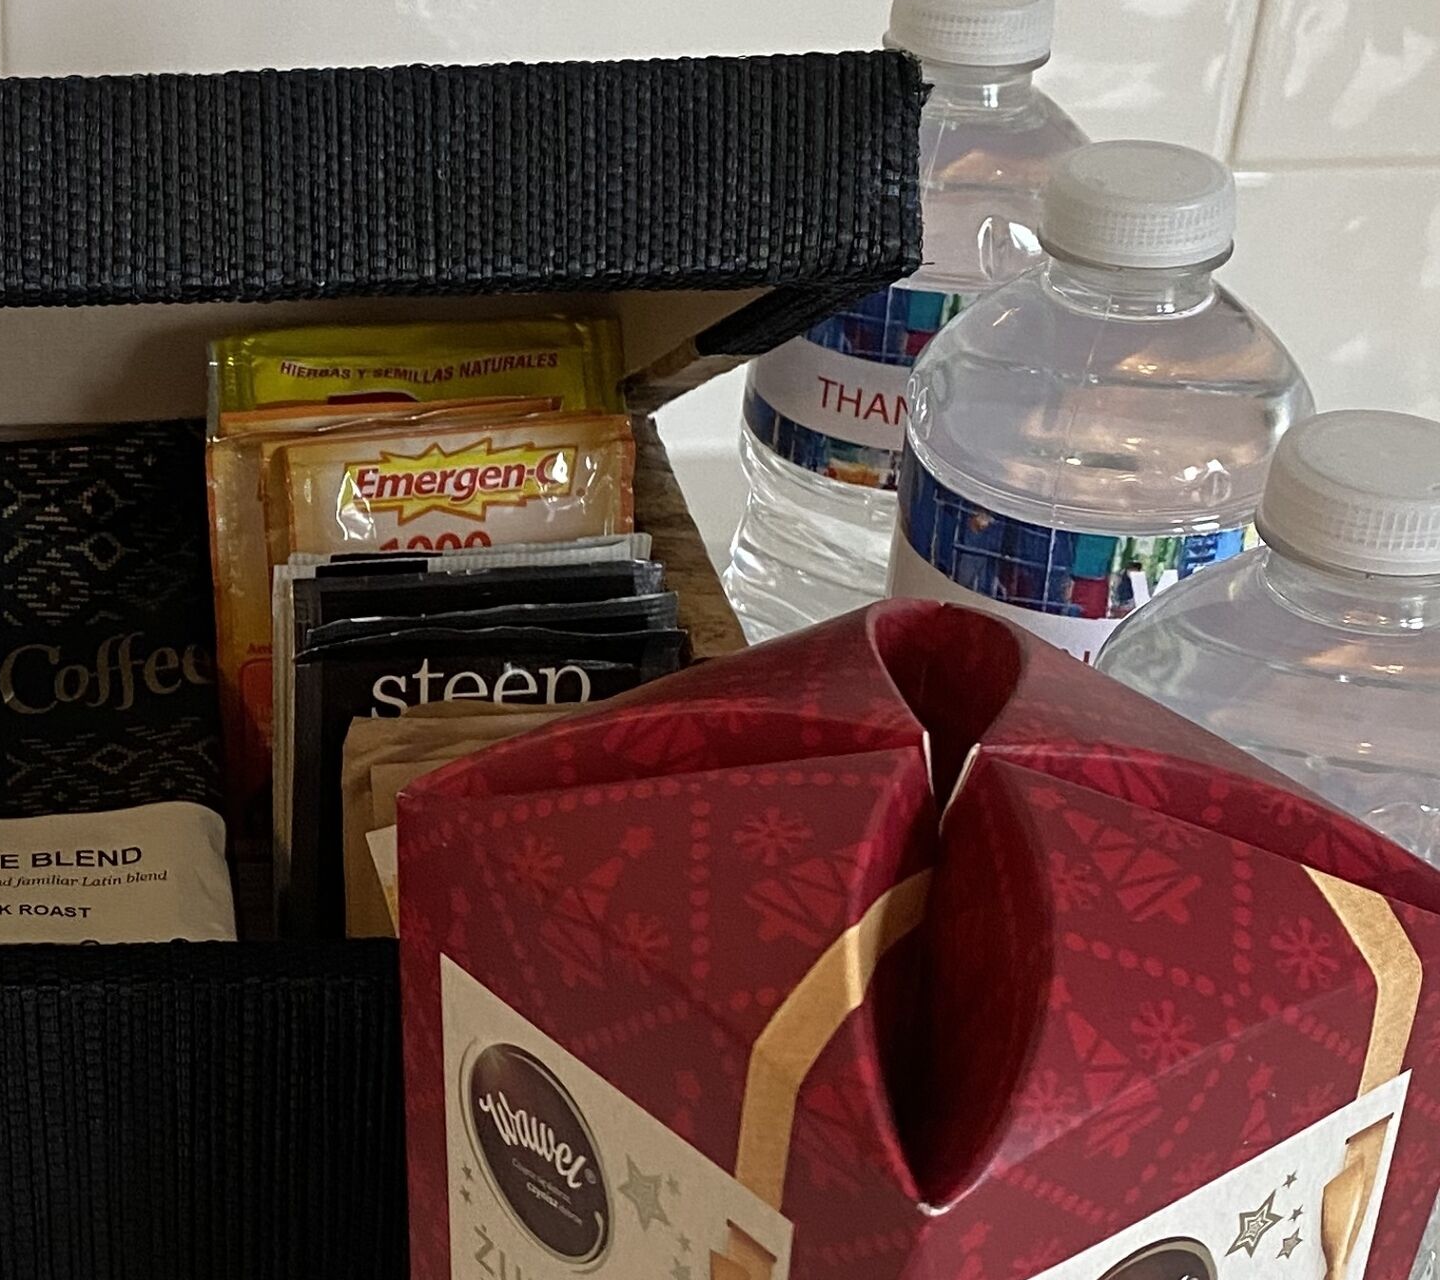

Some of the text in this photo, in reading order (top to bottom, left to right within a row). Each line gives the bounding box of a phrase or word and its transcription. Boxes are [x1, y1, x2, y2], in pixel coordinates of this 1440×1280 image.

[280, 352, 558, 385] HIERBAS Y SEMILLAS NATURALES
[357, 452, 567, 503] Emergen-C
[31, 846, 142, 868] BLEND
[14, 875, 79, 889] familiar
[82, 875, 121, 887] Latin
[127, 870, 168, 883] blend
[19, 904, 92, 918] ROAST
